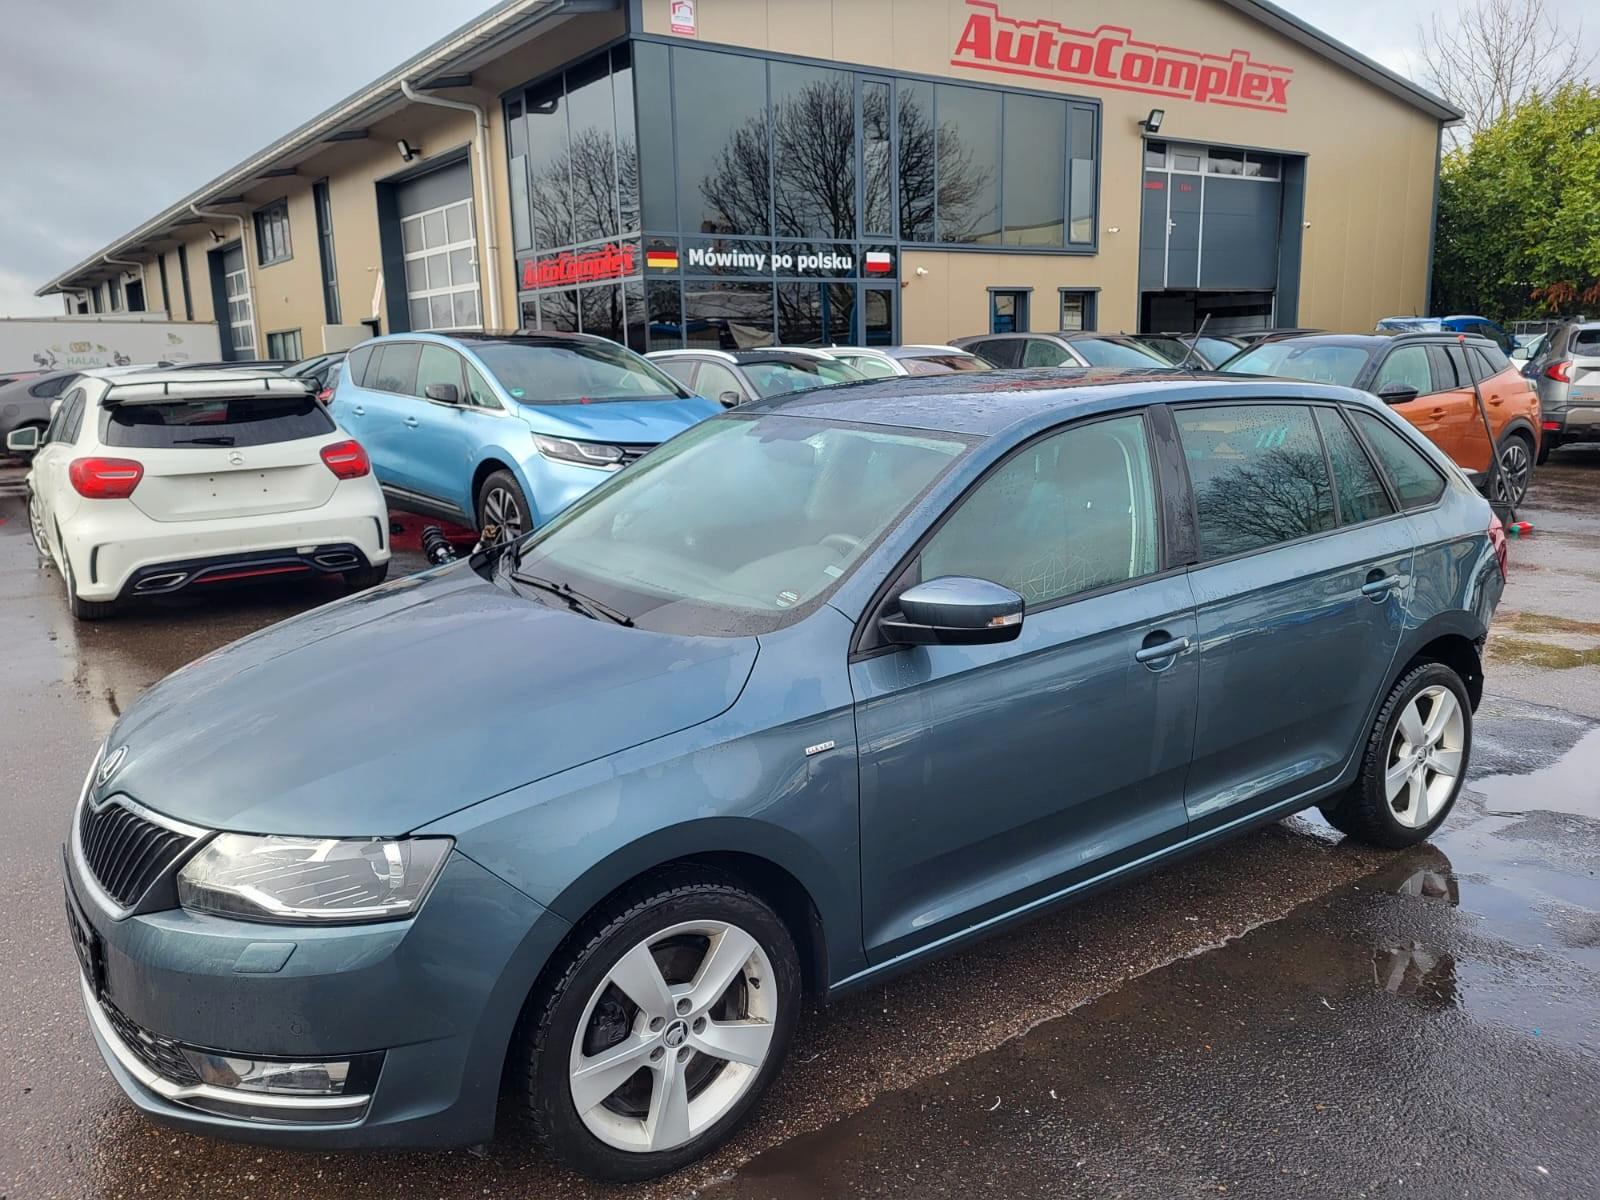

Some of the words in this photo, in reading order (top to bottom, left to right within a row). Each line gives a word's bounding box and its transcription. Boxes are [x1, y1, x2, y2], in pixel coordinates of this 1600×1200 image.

[954, 13, 1292, 104] AutoComplex
[688, 247, 766, 271] Mówimy
[771, 254, 793, 272] po
[797, 252, 852, 272] polsku
[66, 357, 102, 366] HALAL
